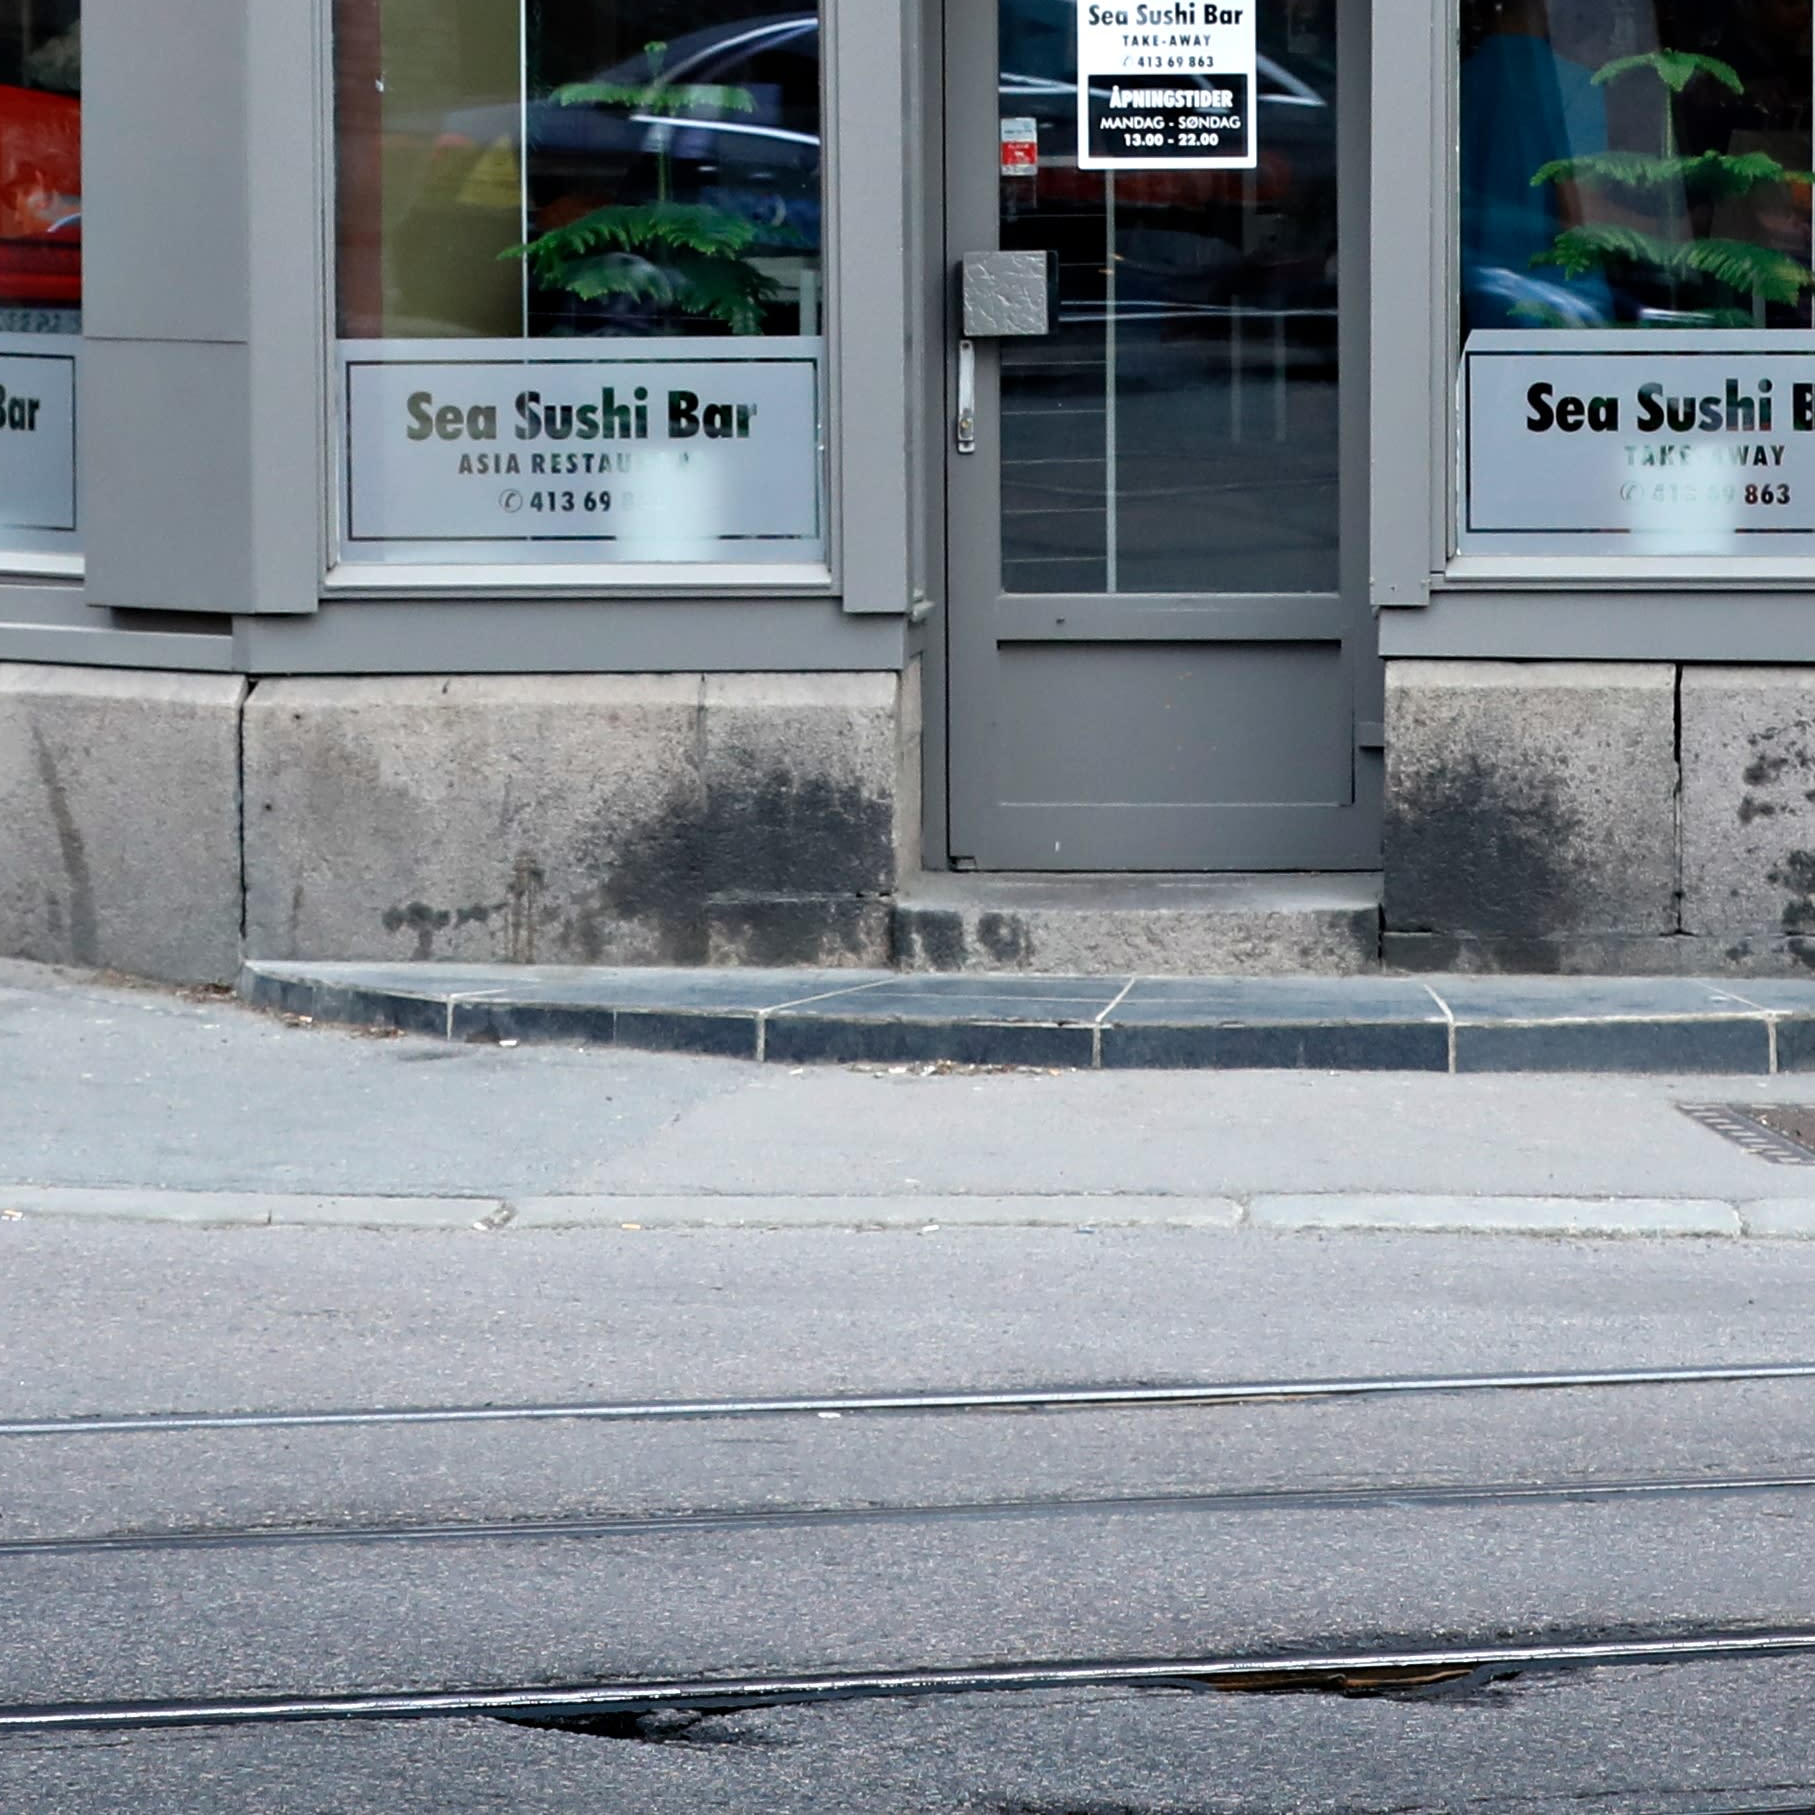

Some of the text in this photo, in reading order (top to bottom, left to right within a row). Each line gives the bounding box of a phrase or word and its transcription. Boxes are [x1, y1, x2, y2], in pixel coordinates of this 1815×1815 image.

[1088, 2, 1243, 26] Sea Sushi Bar
[1122, 34, 1211, 47] TAKE-AWAY
[1137, 56, 1214, 68] 413 69 863
[1109, 85, 1234, 109] ÅPNINGSTIDER
[1100, 116, 1166, 130] MANDAG
[1178, 115, 1242, 130] SØNDAG
[1124, 133, 1164, 147] 13.00
[1178, 133, 1220, 147] 22.00
[406, 386, 759, 442] Sea Sushi Bar
[1526, 381, 1620, 433] Sea
[1636, 378, 1774, 433] Sushi
[459, 453, 522, 475] ASIA
[529, 491, 575, 513] 413
[584, 491, 612, 513] 69
[1744, 482, 1792, 506] 863
